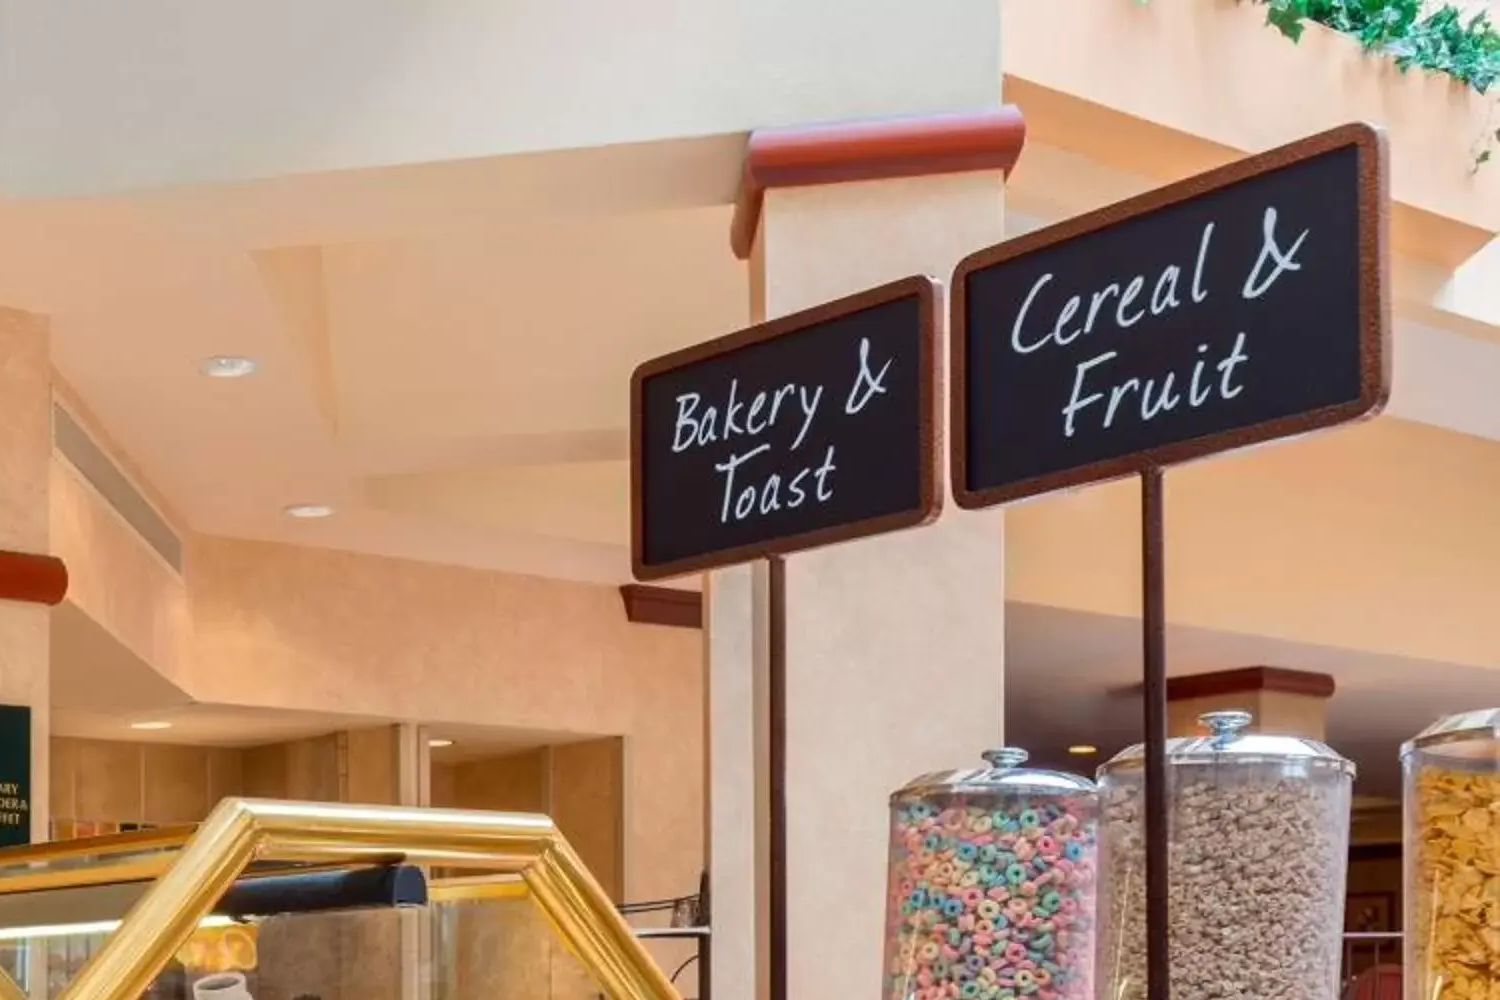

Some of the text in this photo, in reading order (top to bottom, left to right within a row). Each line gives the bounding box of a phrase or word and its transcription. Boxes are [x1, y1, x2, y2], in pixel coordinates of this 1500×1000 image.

[1011, 207, 1309, 353] Cereal &
[672, 337, 892, 453] Bakery &
[1062, 332, 1248, 437] Fruit
[715, 443, 836, 523] Toast
